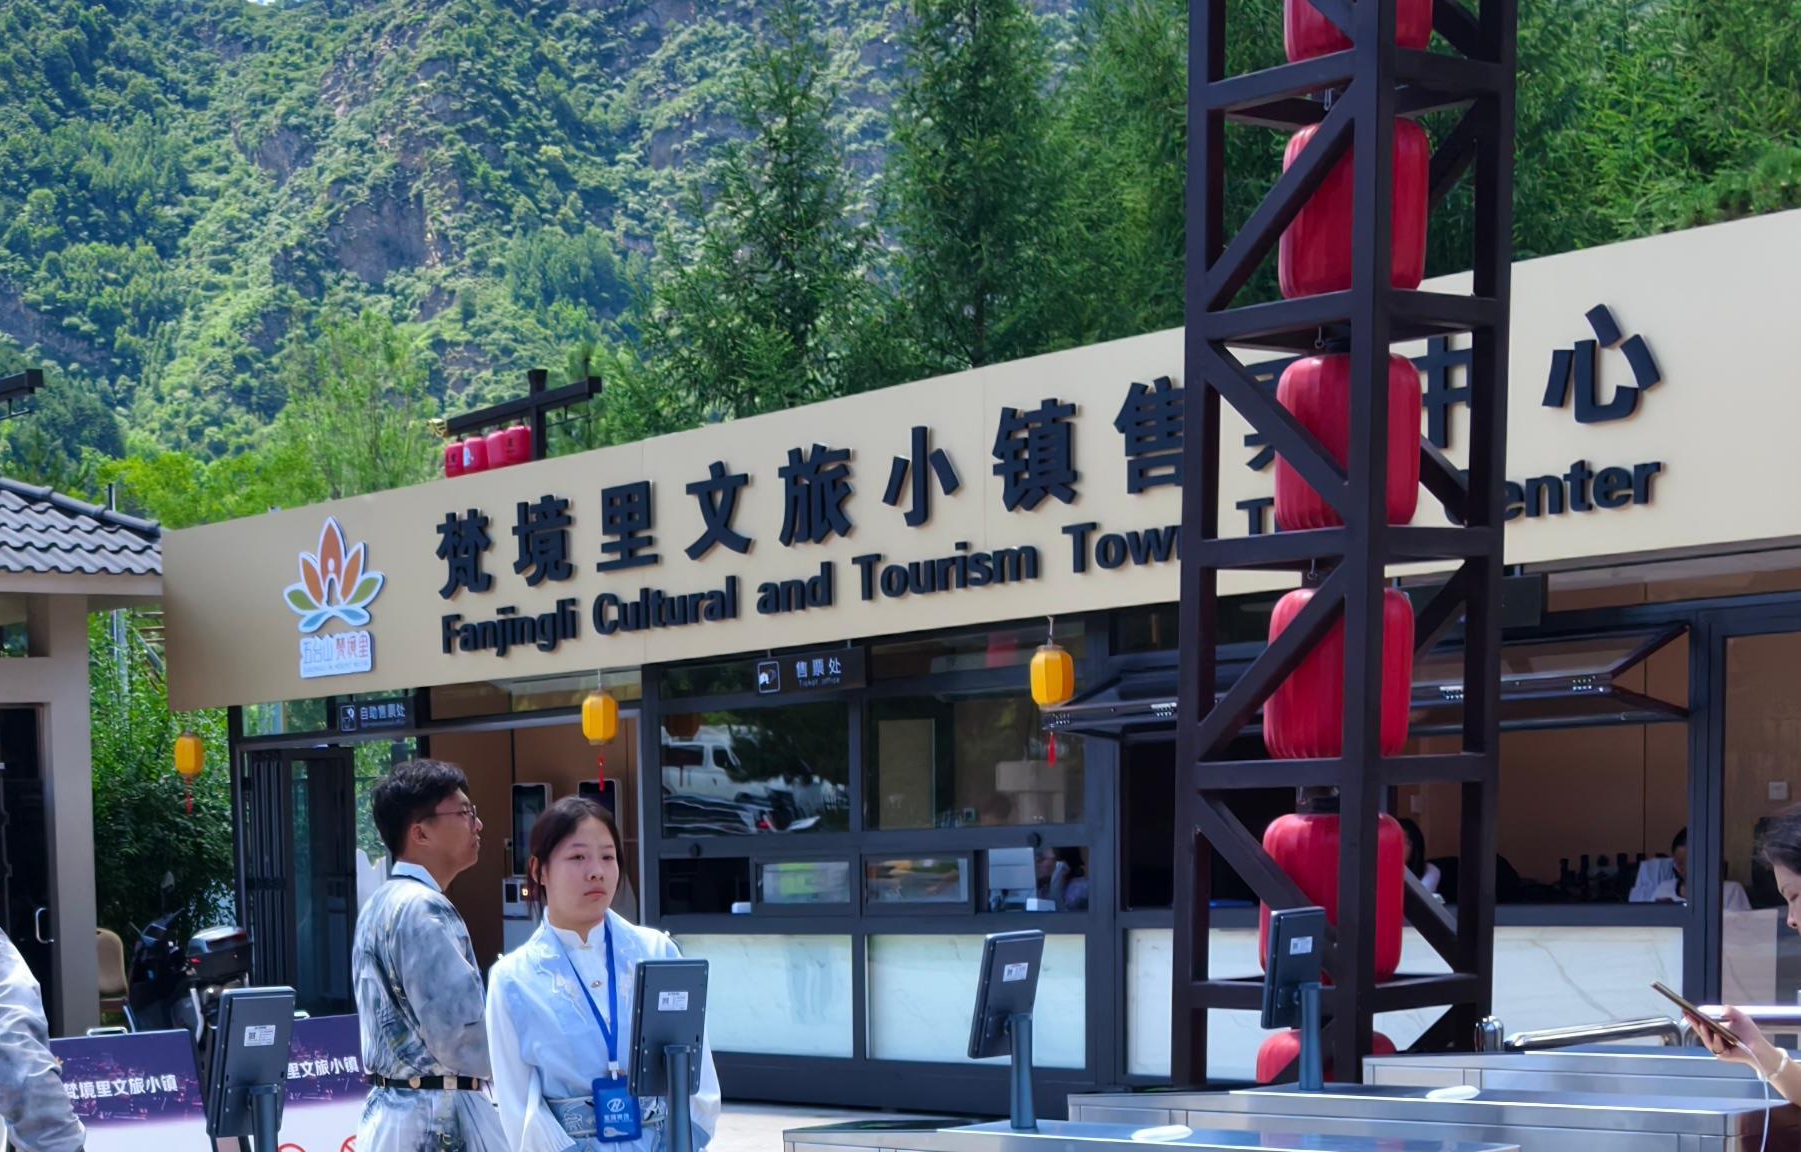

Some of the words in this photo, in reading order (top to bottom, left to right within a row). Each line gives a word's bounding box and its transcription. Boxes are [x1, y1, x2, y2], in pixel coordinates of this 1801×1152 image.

[441, 597, 579, 657] Fanjingli
[592, 574, 739, 636] Cultural
[756, 560, 833, 616] and
[851, 541, 1039, 600] Tourism
[1061, 521, 1183, 574] Tow
[1444, 459, 1662, 526] enter
[796, 657, 842, 678] 售票处
